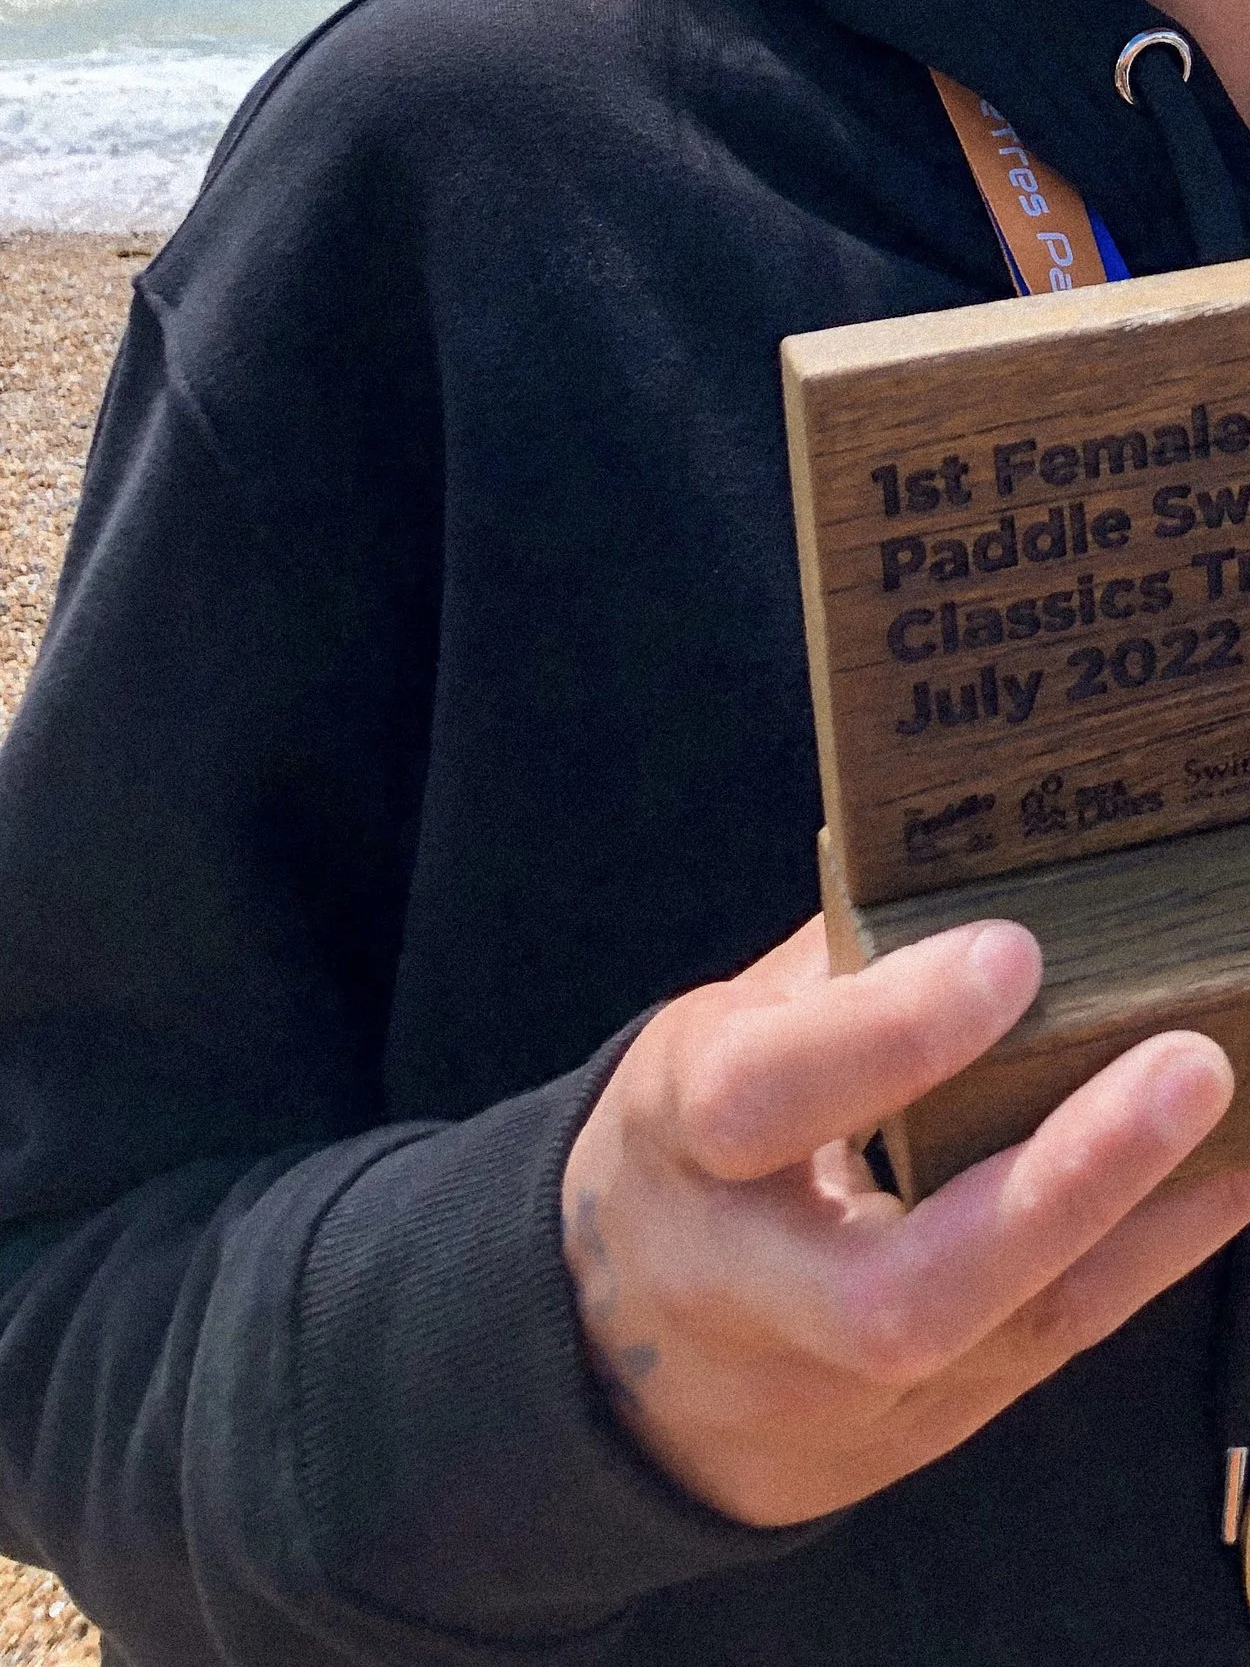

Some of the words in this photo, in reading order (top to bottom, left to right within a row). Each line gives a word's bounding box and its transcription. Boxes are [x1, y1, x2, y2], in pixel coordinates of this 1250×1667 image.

[873, 455, 971, 517] 1st
[881, 504, 1131, 591] Paddle
[887, 568, 1174, 662] Classics
[896, 665, 1043, 735] July
[1067, 619, 1244, 702] 2022
